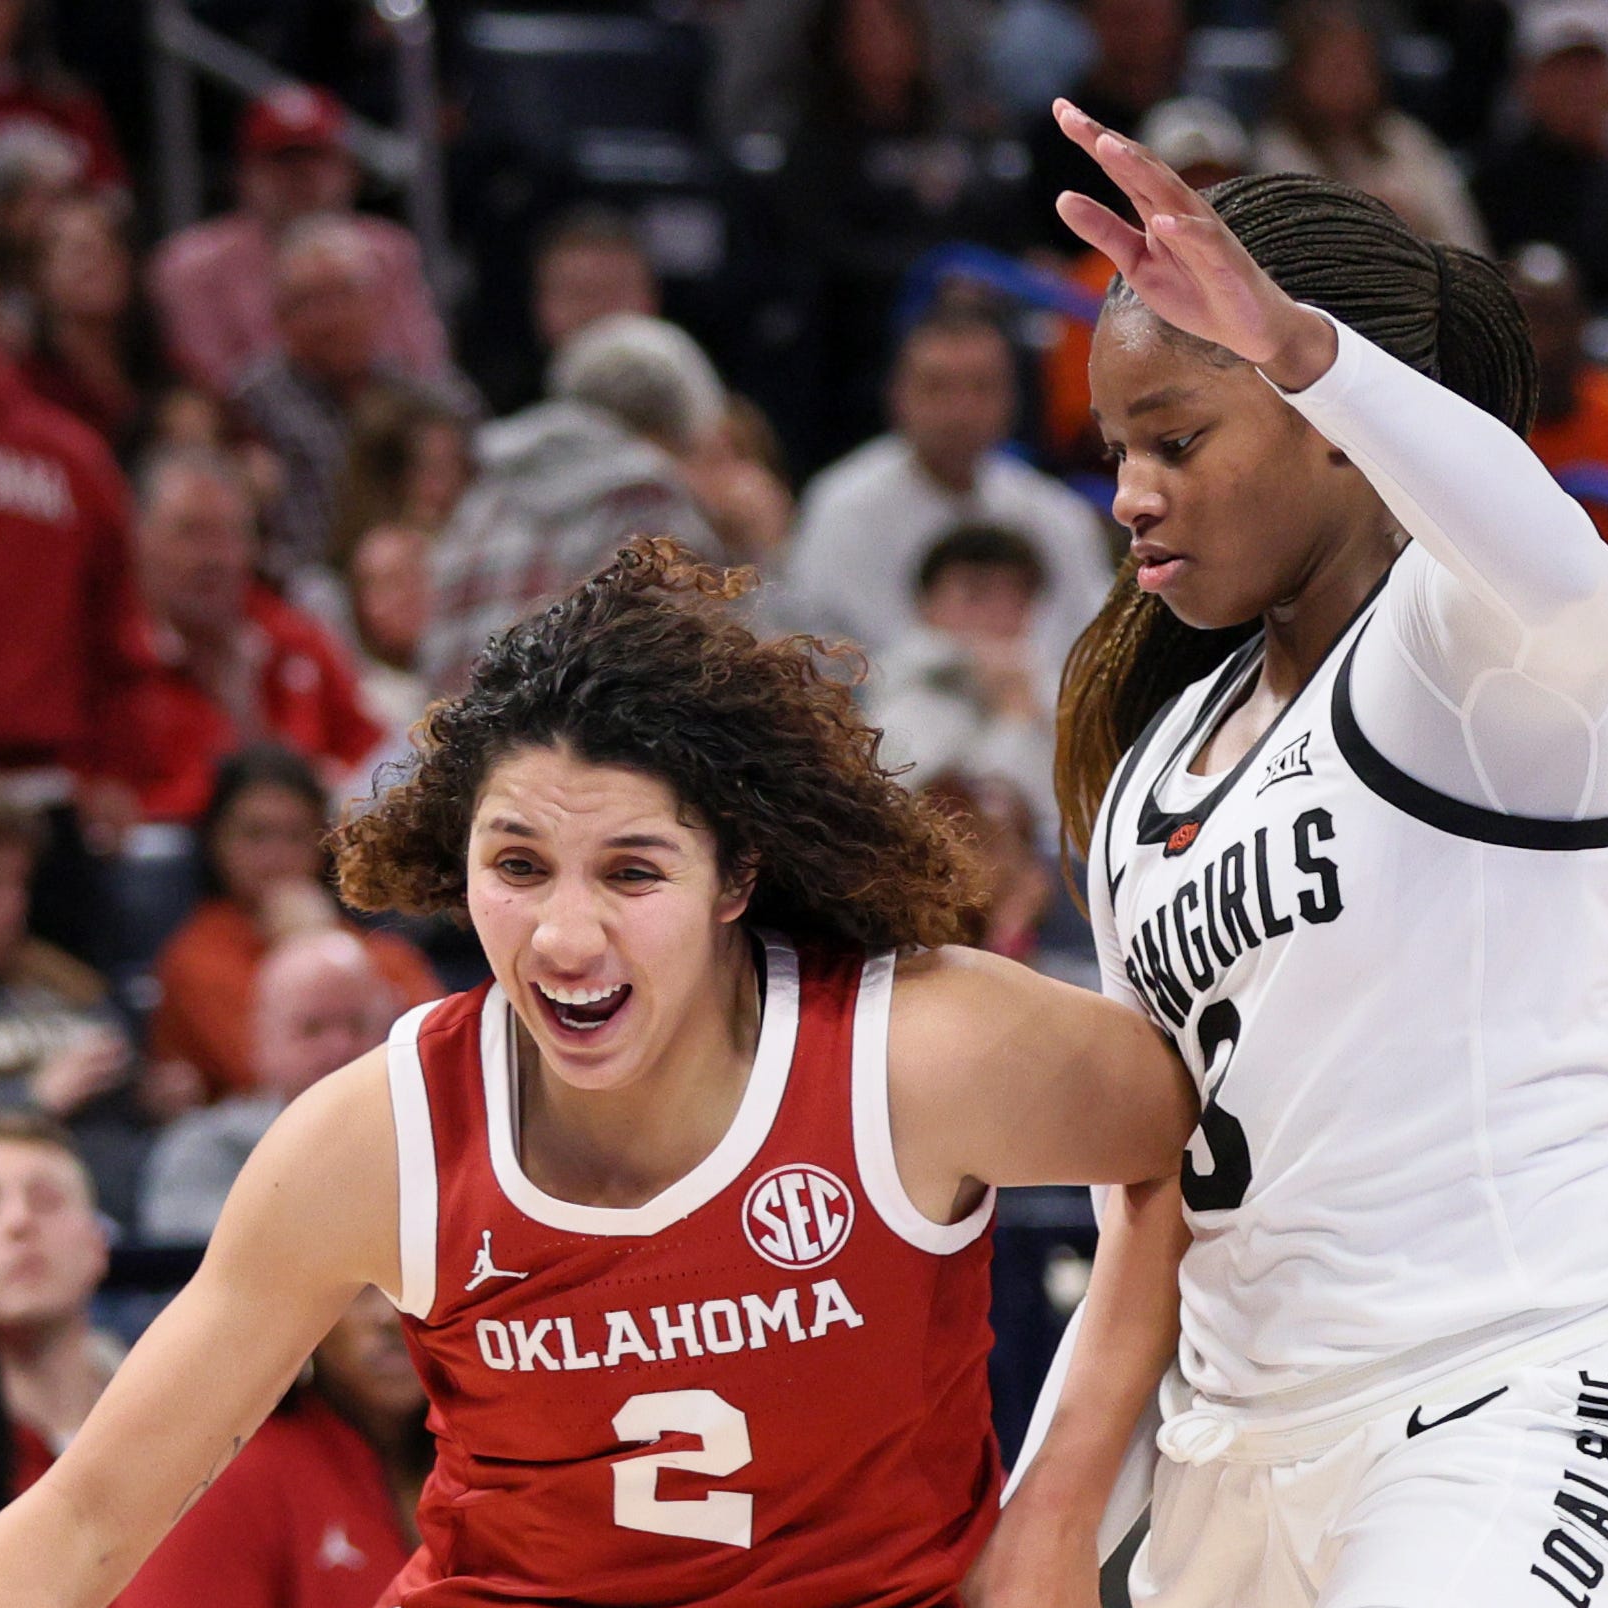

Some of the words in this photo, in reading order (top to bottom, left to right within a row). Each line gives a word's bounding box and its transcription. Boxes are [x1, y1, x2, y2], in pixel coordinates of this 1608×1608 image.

[750, 1171, 845, 1263] SEC
[475, 1278, 865, 1372] OKLAHOMA
[610, 1388, 754, 1550] 2
